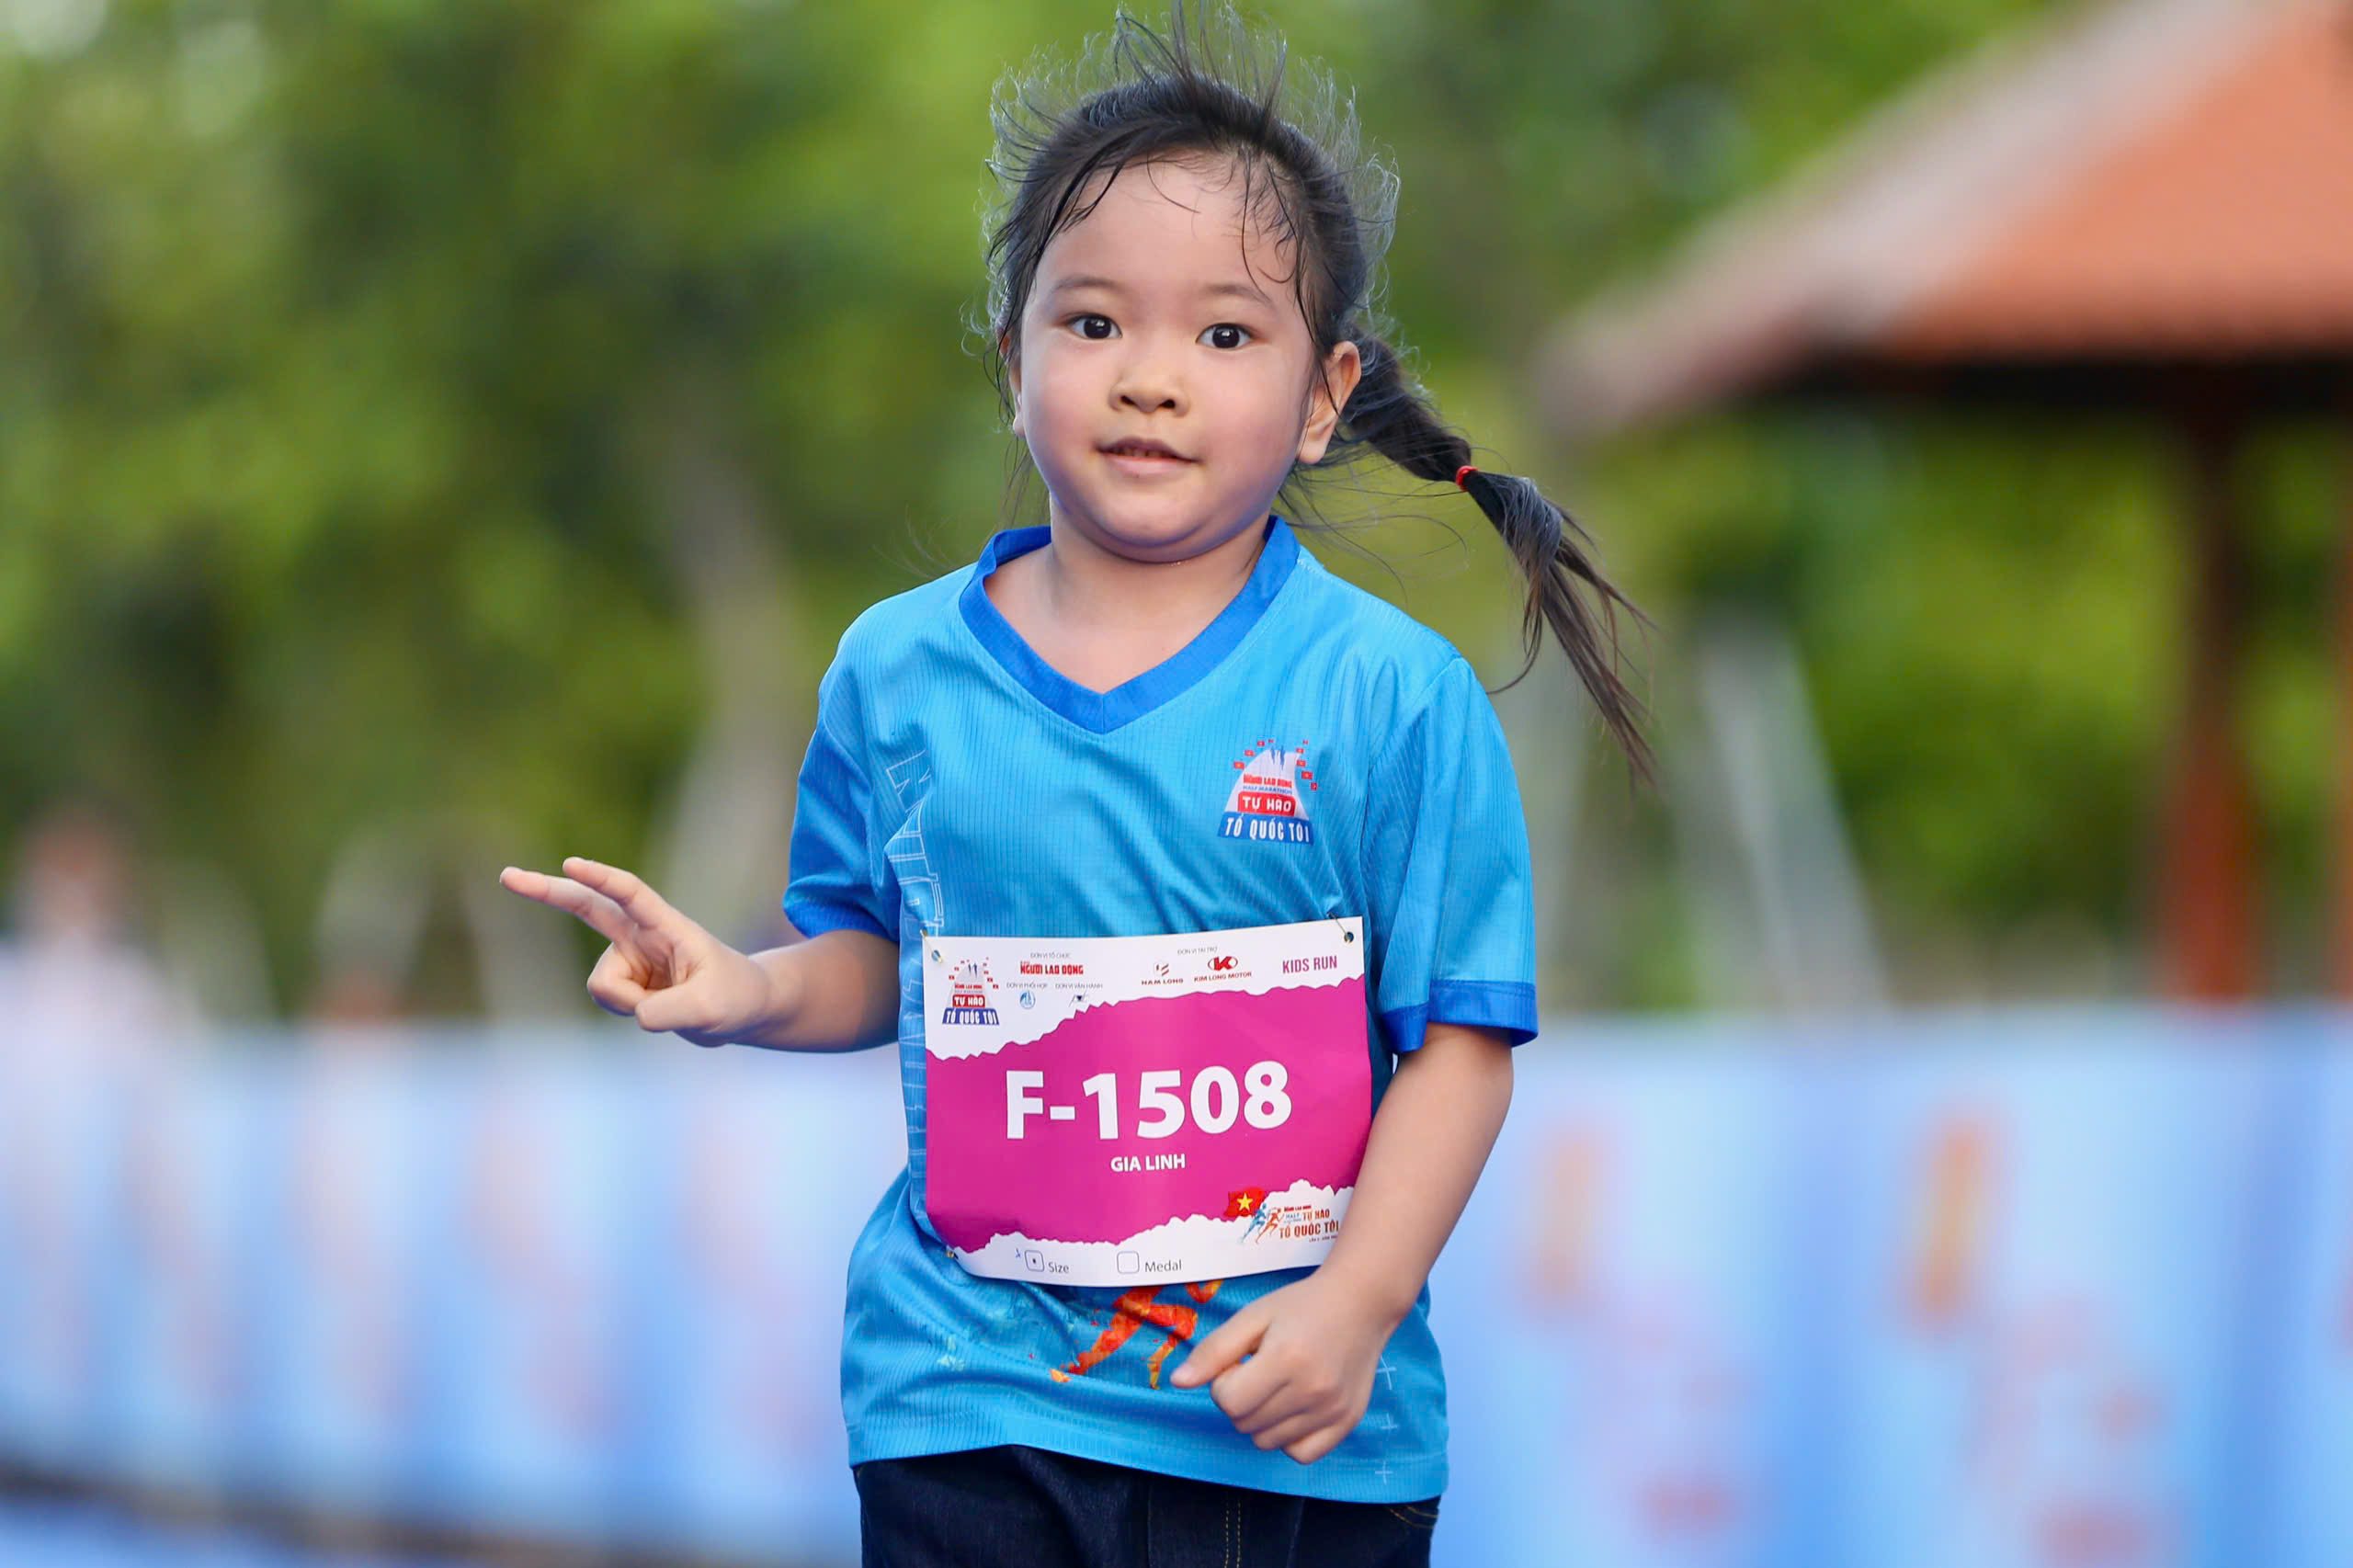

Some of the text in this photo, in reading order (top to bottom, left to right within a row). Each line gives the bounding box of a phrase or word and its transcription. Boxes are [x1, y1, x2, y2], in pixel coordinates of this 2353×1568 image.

[1282, 955, 1338, 974] KIDS RUN
[1006, 1060, 1292, 1141] F-1508
[1110, 1153, 1186, 1173] GIA LINH
[1048, 1262, 1069, 1274] Size
[1144, 1259, 1182, 1273] Medal
